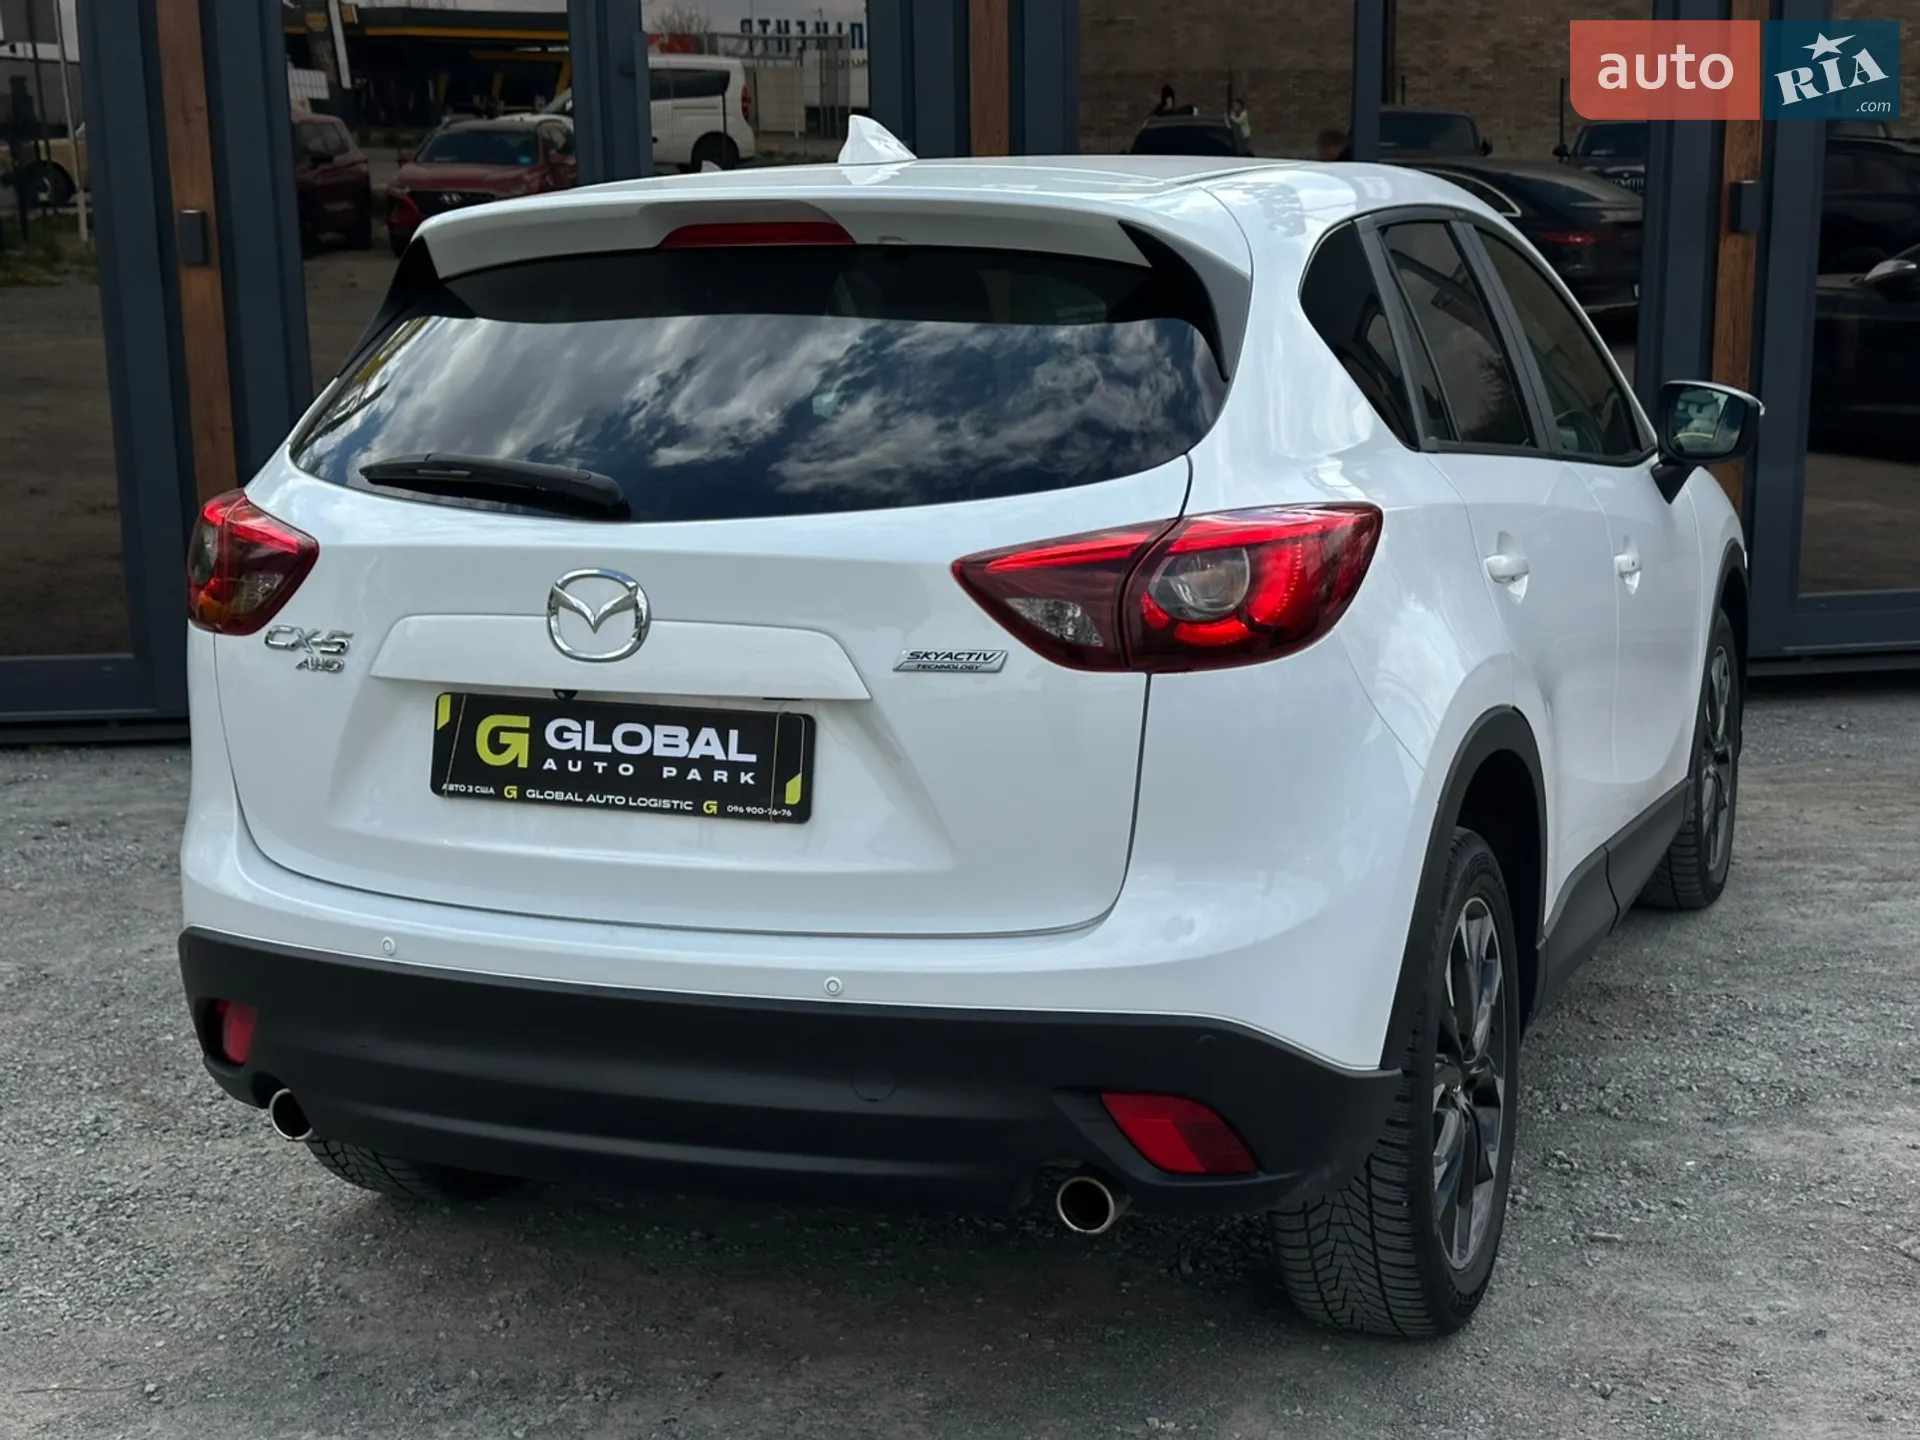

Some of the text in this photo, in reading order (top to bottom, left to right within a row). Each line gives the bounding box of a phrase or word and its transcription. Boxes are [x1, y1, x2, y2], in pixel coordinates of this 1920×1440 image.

[264, 624, 354, 656] CX-5
[295, 656, 345, 673] AWD
[907, 651, 996, 662] SKYACTIV
[545, 717, 757, 763] GLOBAL
[542, 758, 755, 785] AUTO PARK
[441, 783, 466, 792] АВТО
[474, 785, 495, 794] США
[525, 789, 693, 810] GLOBAL AUTO LOGISTIC
